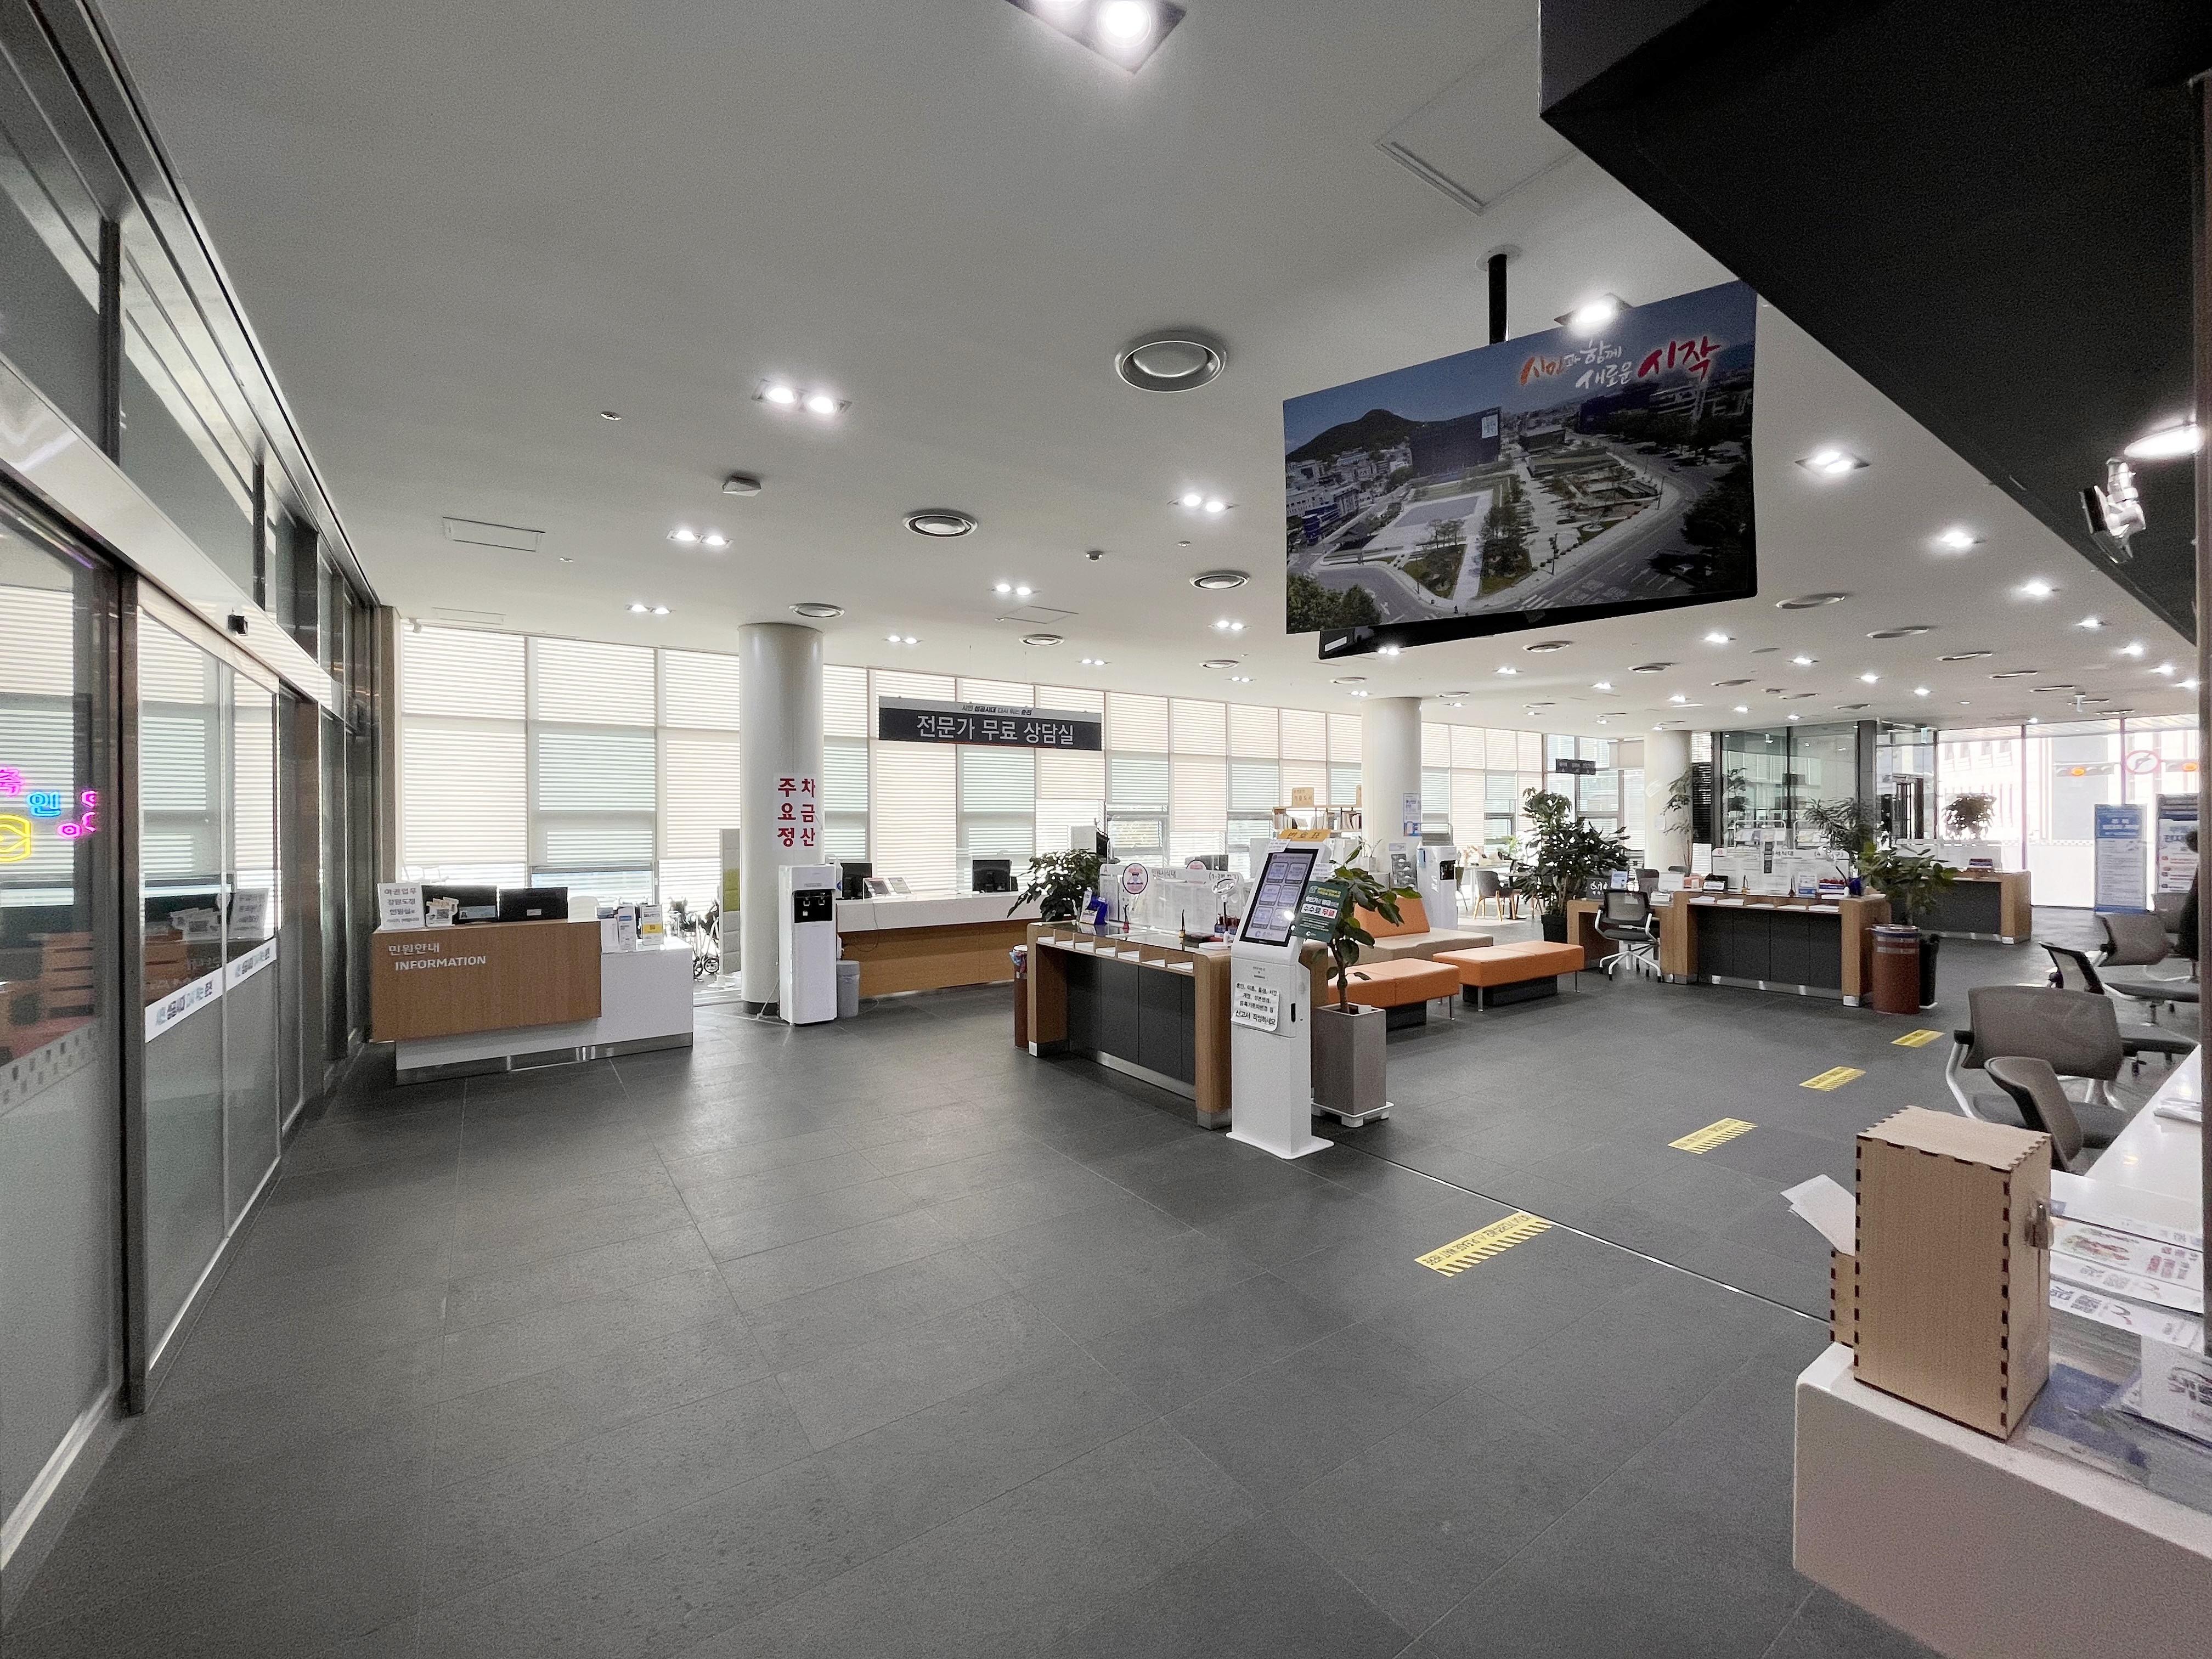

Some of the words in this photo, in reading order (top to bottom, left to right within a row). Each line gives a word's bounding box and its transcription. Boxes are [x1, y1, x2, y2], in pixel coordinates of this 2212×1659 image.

[1520, 353, 1581, 385] 시민과
[1579, 338, 1622, 365] 함께
[1575, 361, 1633, 389] 새로운
[1637, 335, 1721, 381] 시작
[916, 715, 975, 740] 전문가
[981, 720, 1018, 741] 무료
[1023, 722, 1074, 746] 상담실
[777, 778, 816, 798] 주차
[27, 791, 61, 817] 인
[777, 803, 815, 823] 요금
[777, 827, 816, 848] 정산
[1322, 909, 1335, 917] 무료
[388, 942, 439, 956] 민원안내
[395, 956, 487, 971] INFORMATION
[1235, 1010, 1251, 1020] 신고서
[1422, 1253, 1443, 1266] HERE
[1441, 1246, 1458, 1257] WAIT
